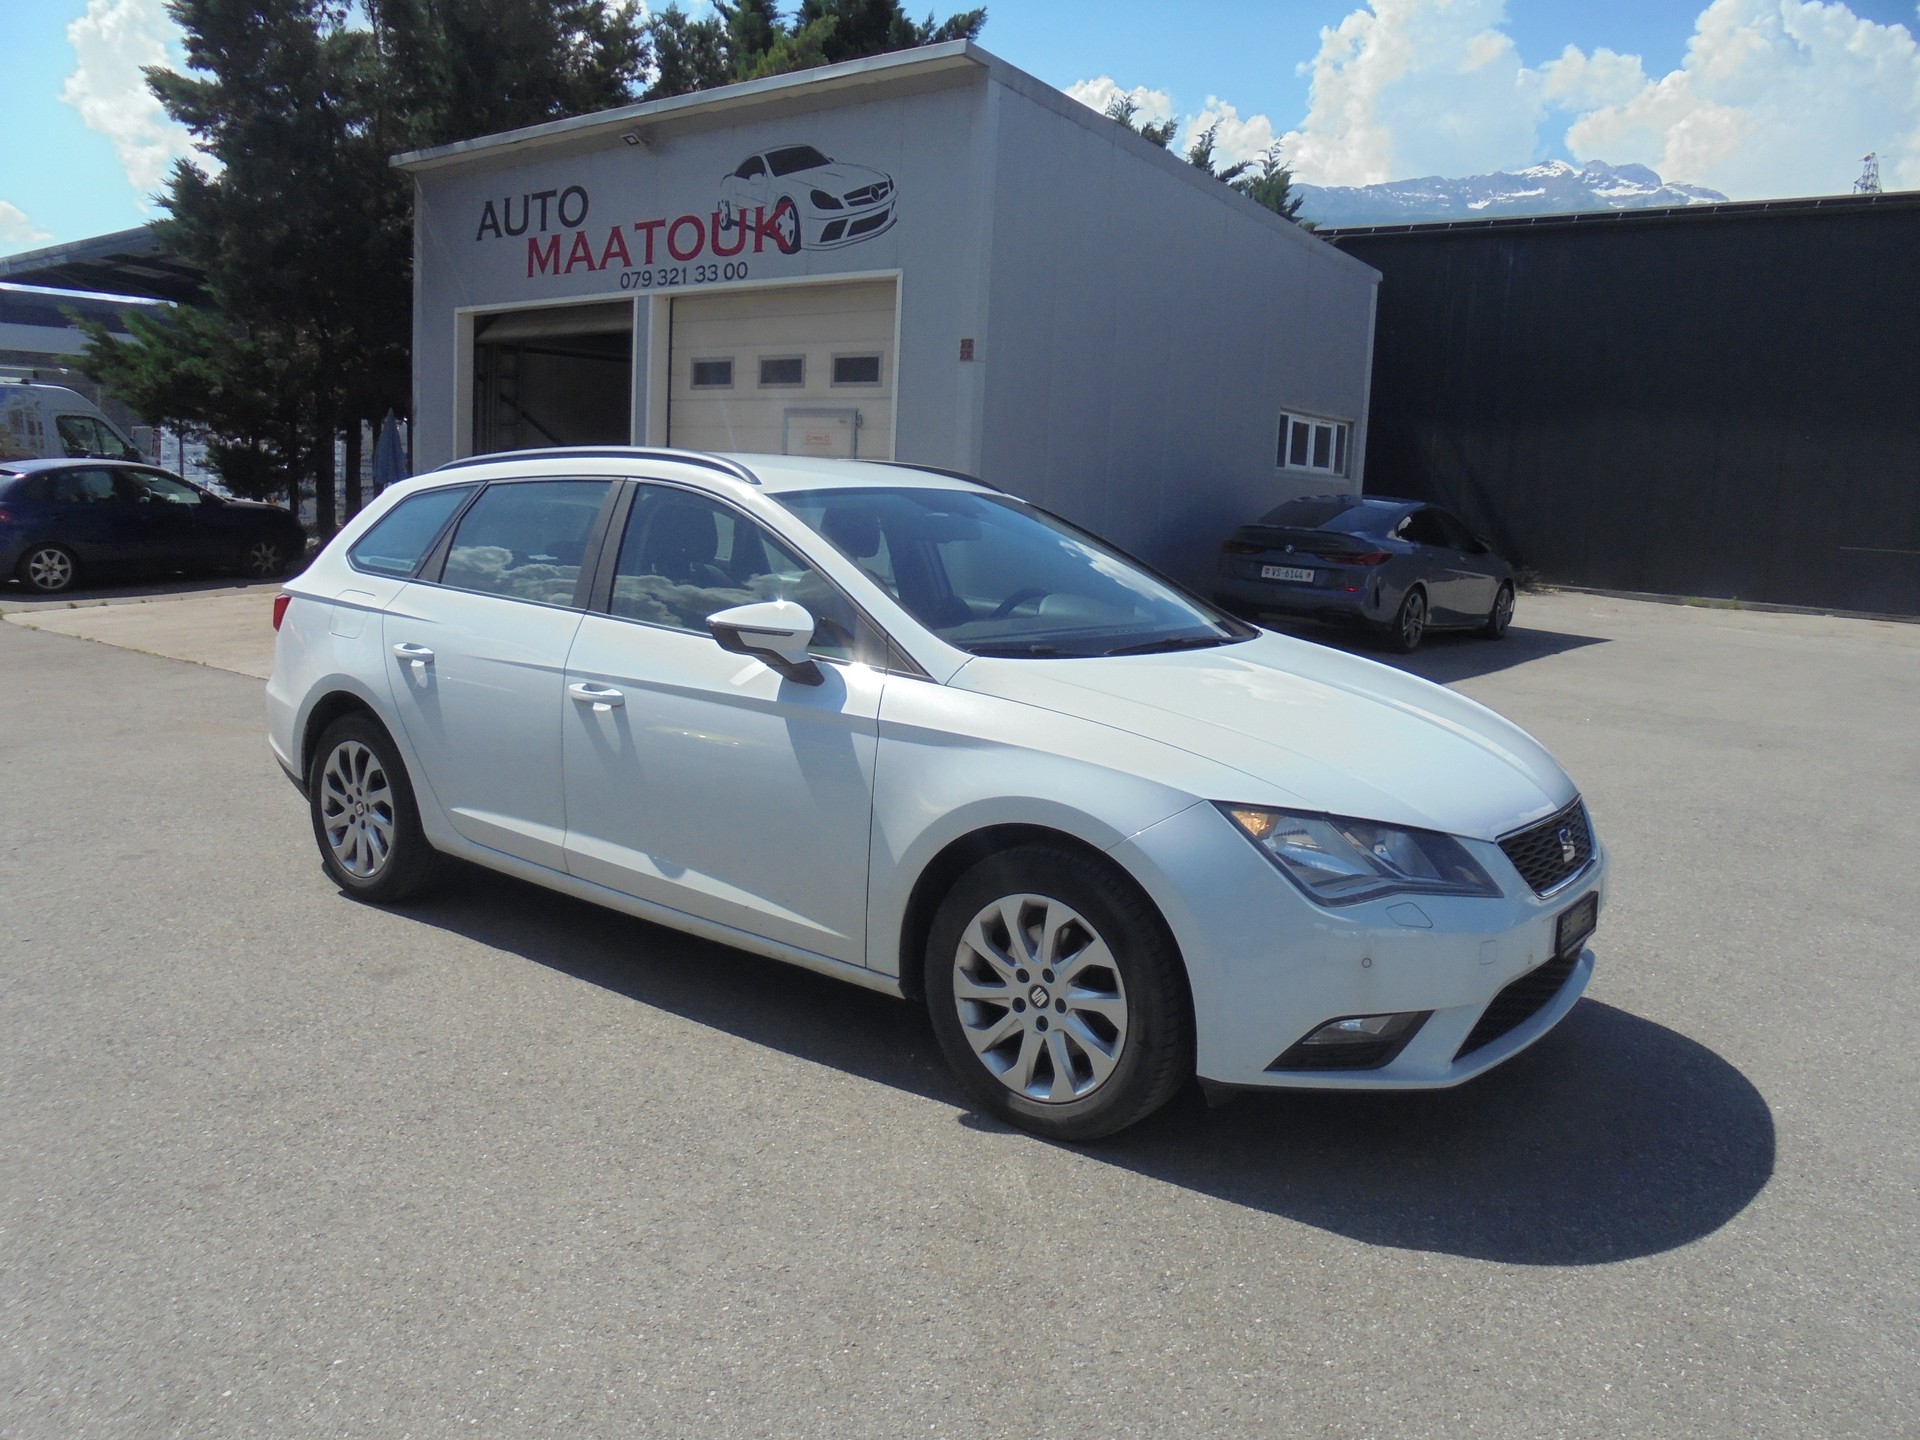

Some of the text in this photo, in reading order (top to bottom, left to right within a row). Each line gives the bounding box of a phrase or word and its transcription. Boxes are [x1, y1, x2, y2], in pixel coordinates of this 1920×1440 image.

[476, 185, 589, 241] AUTO
[527, 201, 796, 278] MAATOUK
[619, 261, 749, 289] 079 321 33 00
